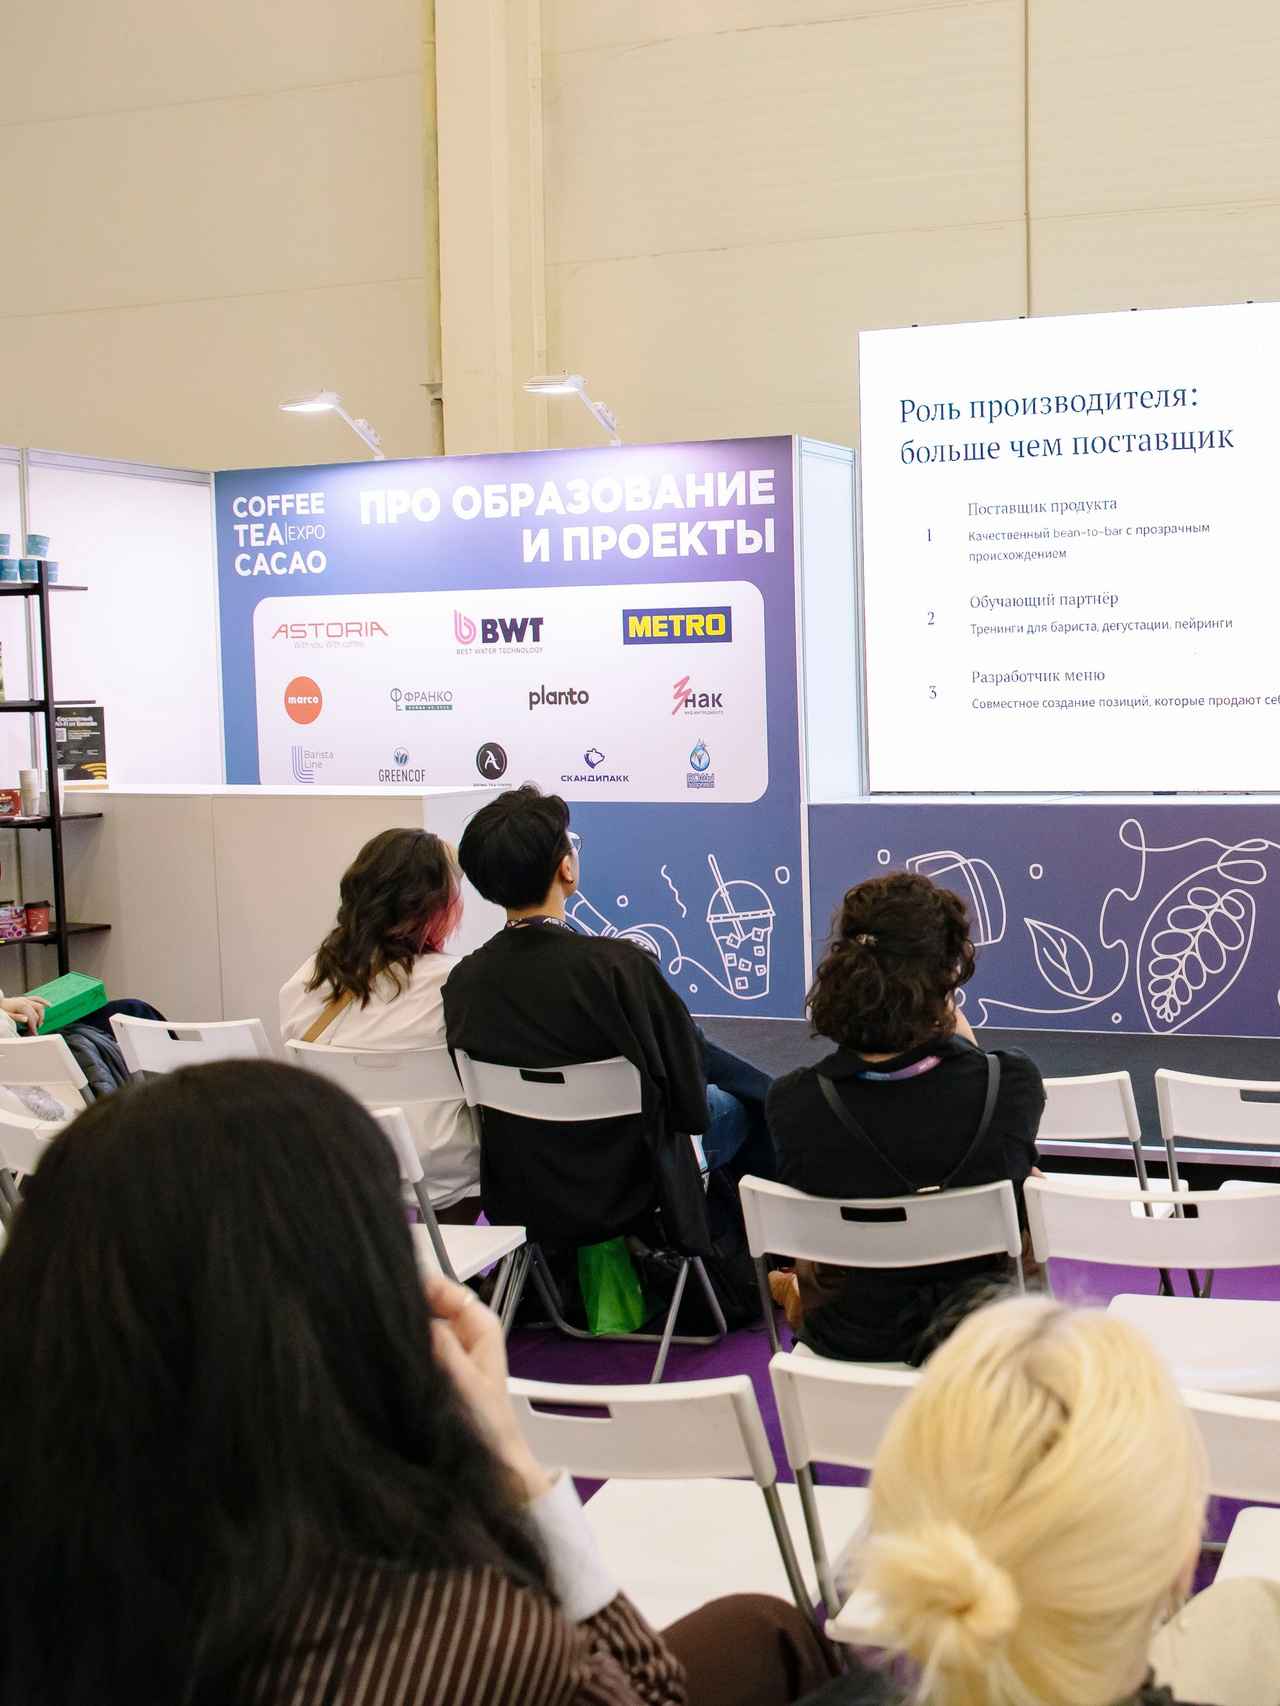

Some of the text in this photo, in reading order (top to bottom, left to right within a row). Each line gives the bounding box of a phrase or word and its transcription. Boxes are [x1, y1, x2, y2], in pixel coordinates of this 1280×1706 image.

[900, 388, 1197, 424] Роль производителя:
[900, 429, 1235, 464] больше чем поставщик
[232, 492, 325, 518] COFFEE
[359, 469, 776, 526] ПРО ОБРАЗОВАНИЕ
[968, 499, 1117, 517] Поставщик продукта
[233, 522, 326, 547] TEA EXPO
[522, 517, 776, 563] И ПРОЕКТЫ
[926, 528, 932, 542] 1
[968, 528, 1050, 542] Качественный
[1053, 527, 1122, 538] bean-to-bar
[1135, 523, 1210, 537] прозрачным
[234, 550, 327, 577] CACAO
[969, 549, 1067, 564] происхождением
[970, 591, 1119, 611] Обучающий партнёр
[628, 613, 727, 638] METRO
[927, 612, 935, 626] 2
[970, 617, 1233, 636] Тренинги для бариста, дегустации, пейринги
[271, 621, 389, 640] ASTORIA
[481, 617, 544, 644] BWT
[293, 640, 310, 649] With
[325, 640, 341, 649] With
[972, 669, 1105, 687] Разработчик меню
[288, 696, 319, 704] marco
[404, 690, 453, 702] ФРАНКО
[529, 684, 590, 711] planto
[929, 685, 937, 700] 3
[972, 697, 1039, 709] Совместное
[1042, 696, 1095, 710] создание
[1099, 695, 1152, 709] позиций,
[1155, 695, 1205, 708] которые
[1208, 694, 1261, 707] продают
[304, 750, 334, 759] Barista
[304, 760, 323, 769] Line
[378, 769, 426, 783] GREENCOF
[560, 774, 630, 783] СКАНДИПАКК
